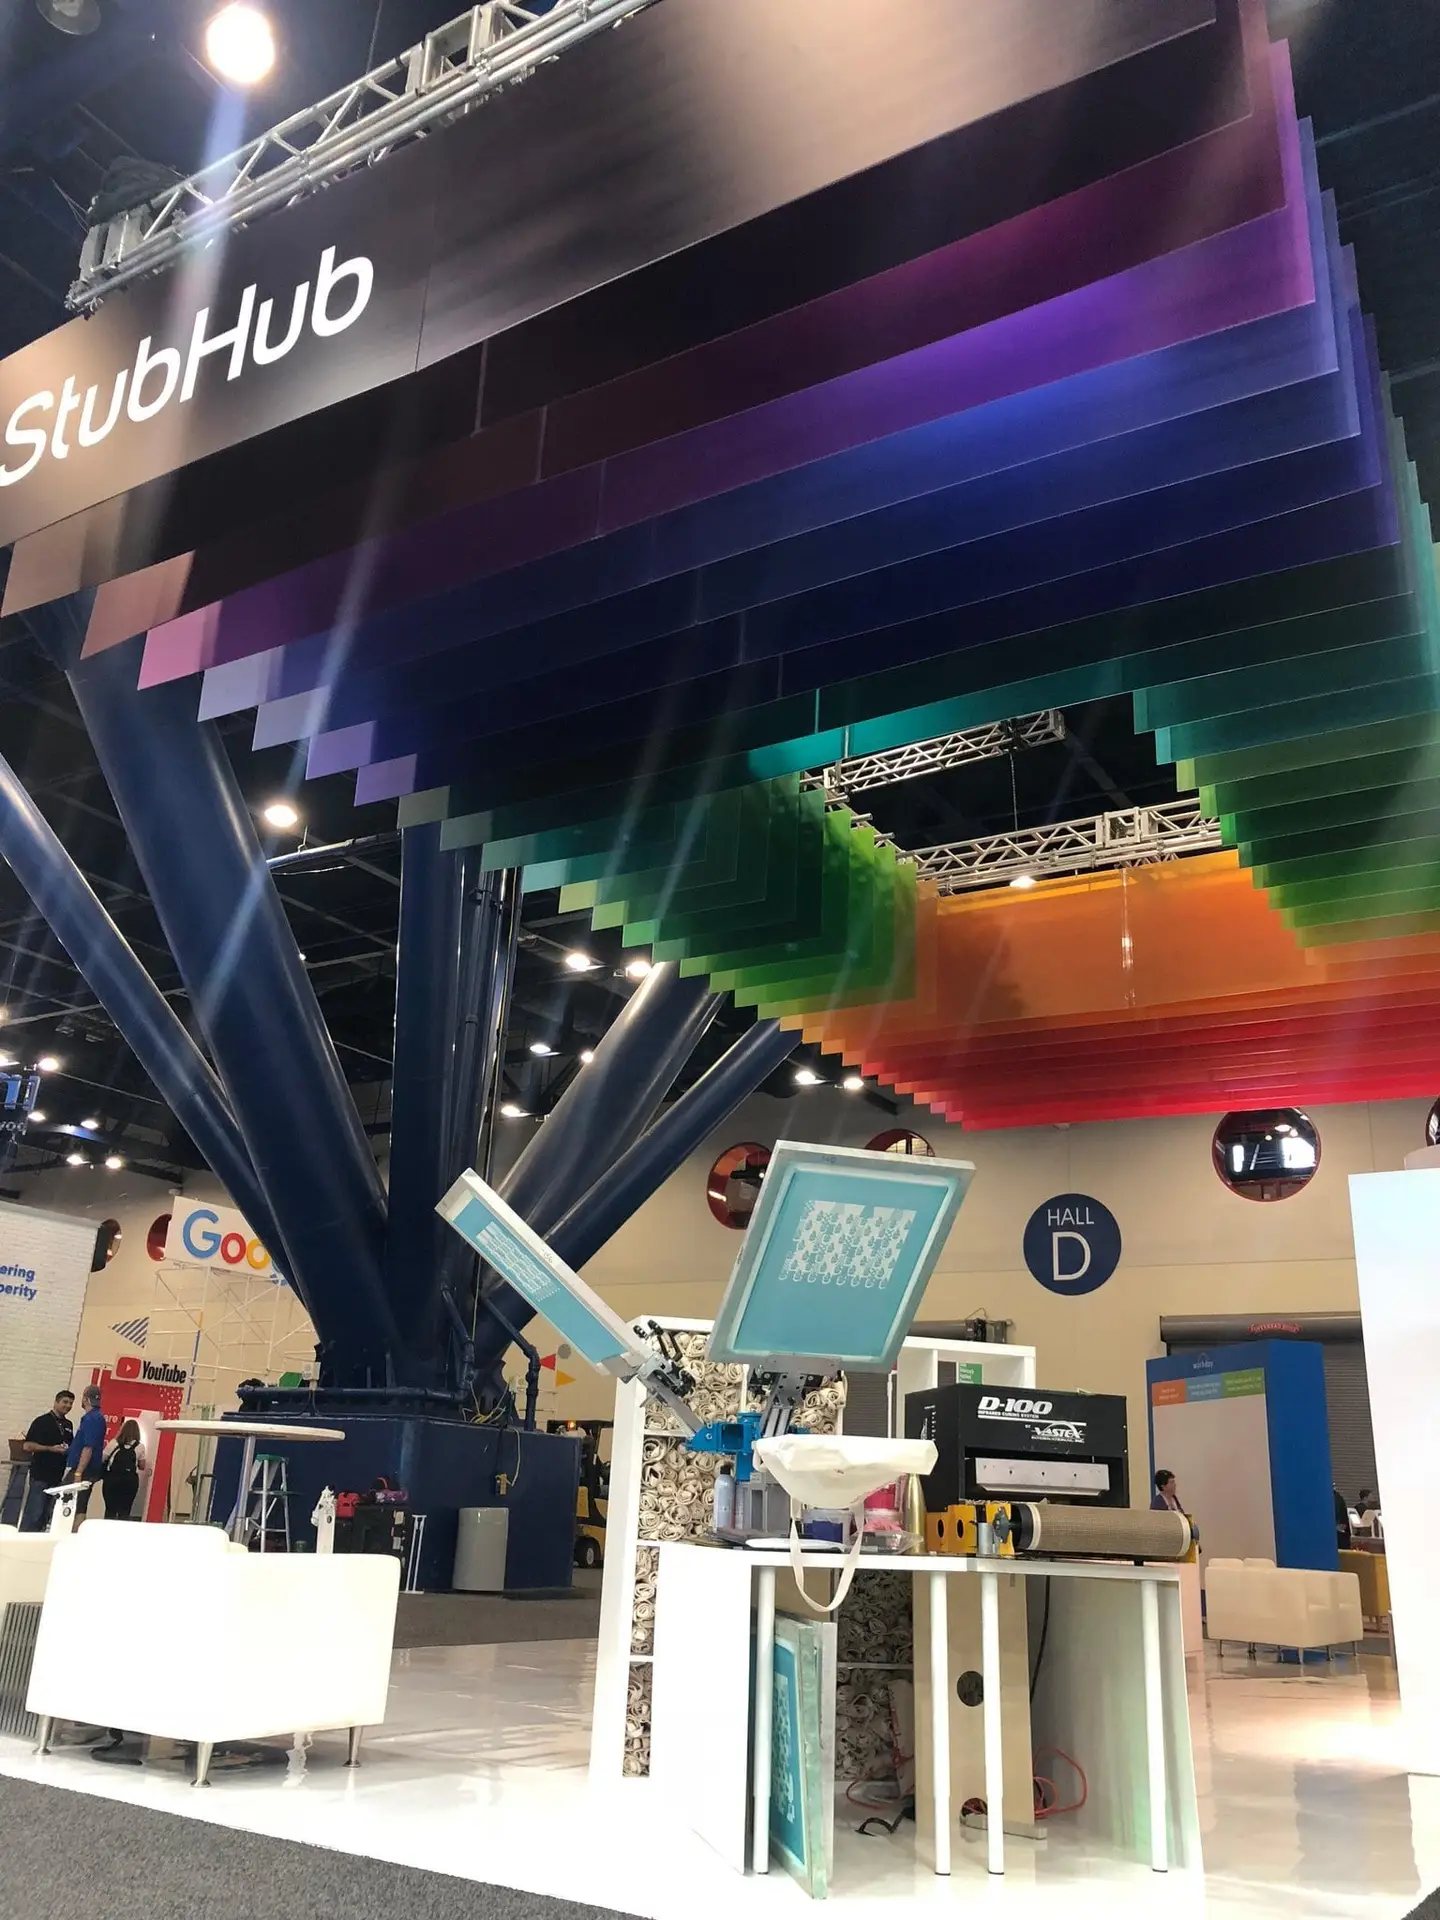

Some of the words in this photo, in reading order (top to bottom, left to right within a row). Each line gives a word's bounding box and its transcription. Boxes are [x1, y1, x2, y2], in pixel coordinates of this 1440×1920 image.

[0, 245, 374, 487] StubHub
[1047, 1206, 1095, 1227] HALL
[1052, 1231, 1091, 1281] D
[142, 1360, 187, 1384] YouTube
[978, 1396, 1053, 1414] D-100
[1033, 1425, 1084, 1439] VASTEX
